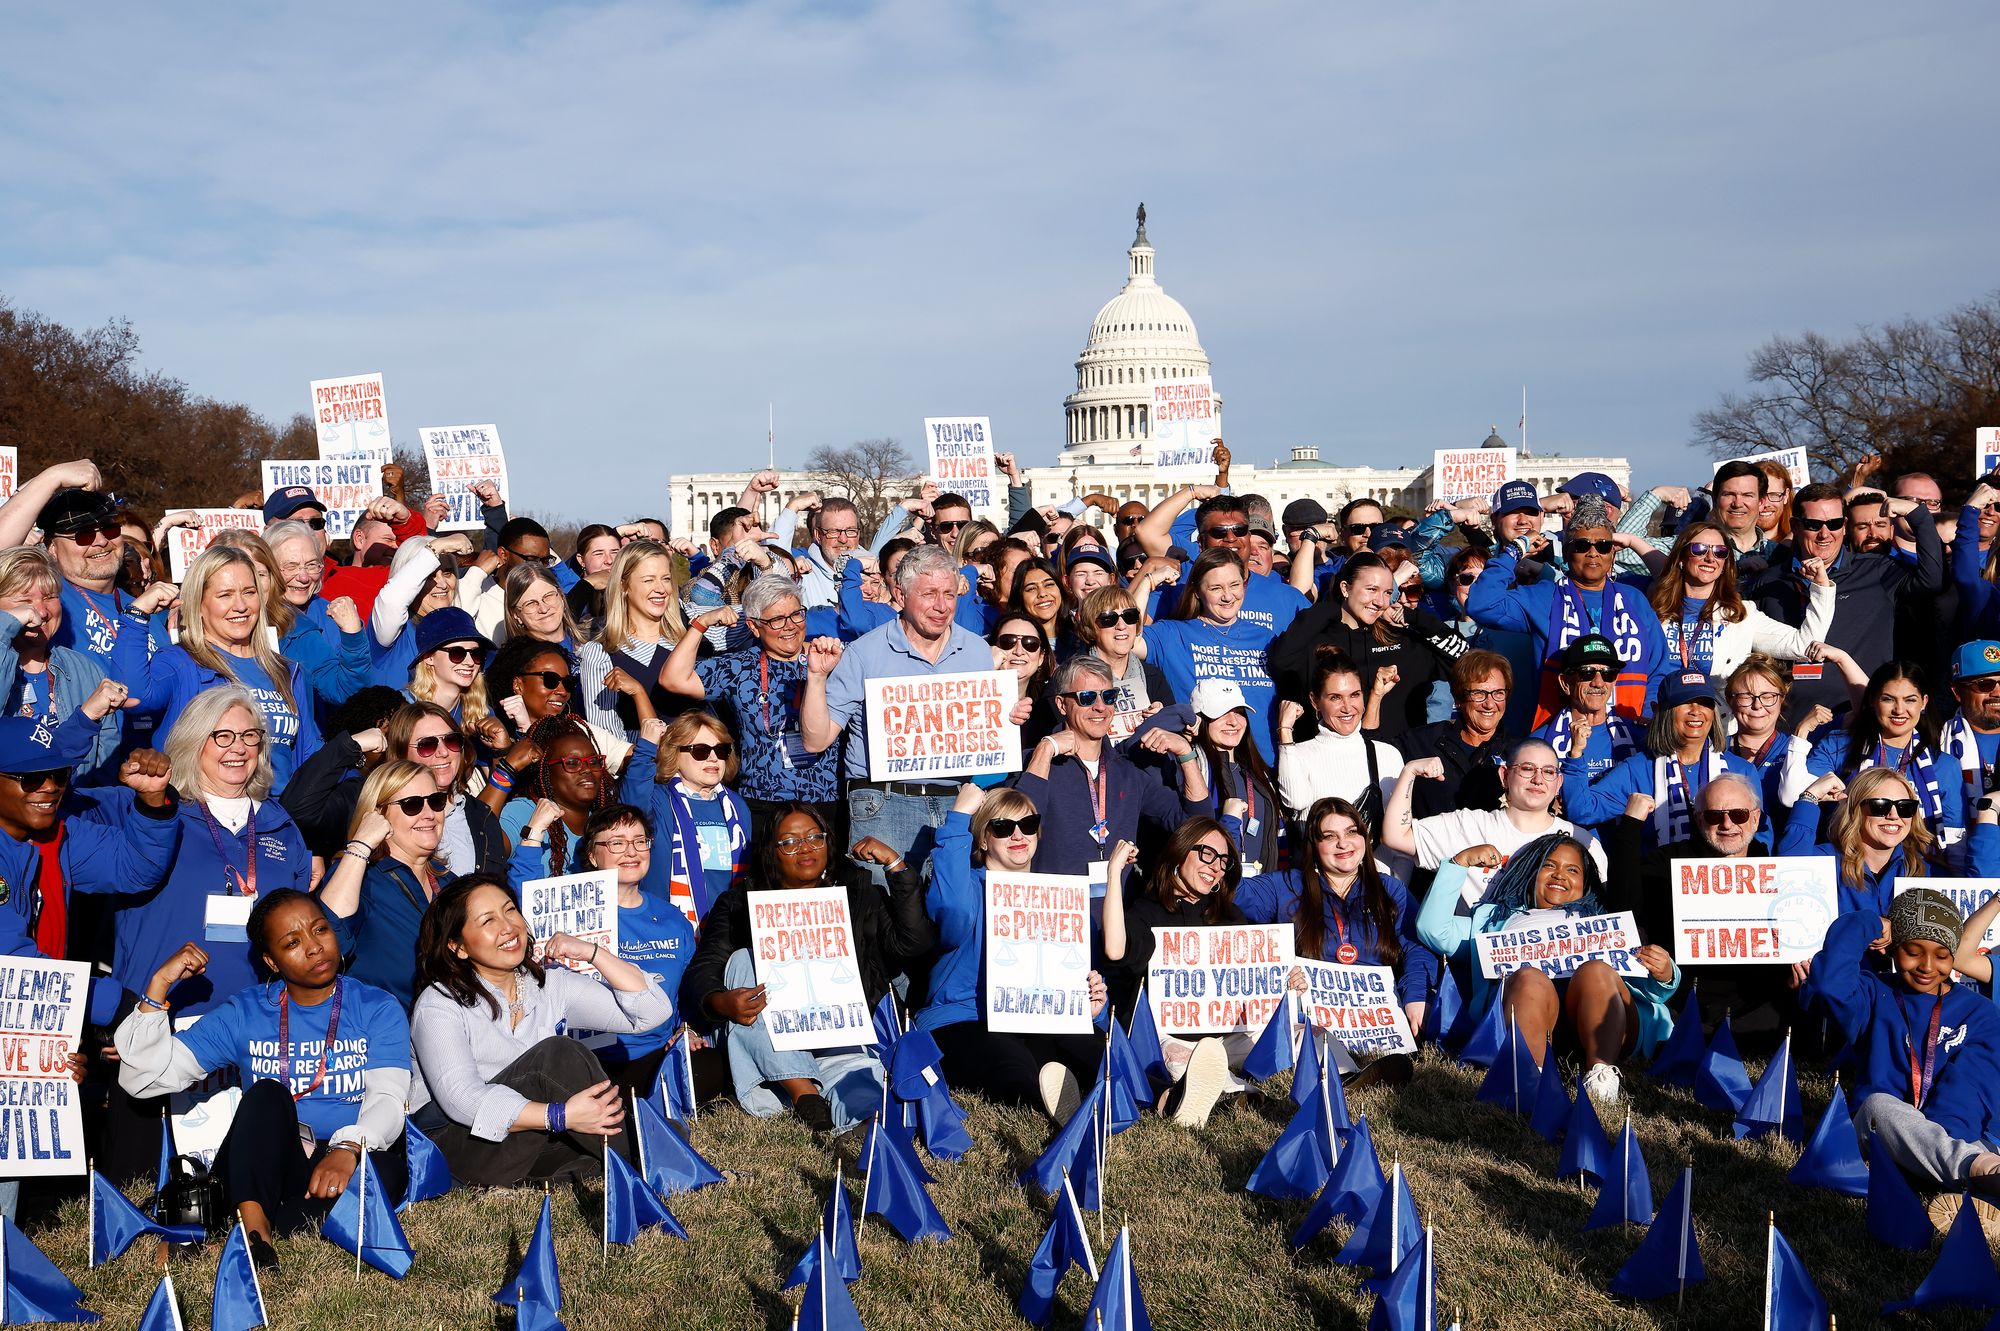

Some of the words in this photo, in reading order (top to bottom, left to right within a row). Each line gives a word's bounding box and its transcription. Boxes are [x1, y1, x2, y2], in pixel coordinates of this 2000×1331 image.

[316, 381, 381, 403] PREVENTION
[1155, 383, 1211, 401] PREVENTION
[320, 408, 332, 424] IS
[333, 399, 383, 424] POWER
[1156, 404, 1167, 421] IS
[1168, 400, 1211, 421] POWER
[430, 430, 490, 445] SILENCE
[931, 422, 984, 444] YOUNG
[432, 444, 465, 457] WILL
[467, 442, 492, 456] NOT
[936, 444, 972, 458] PEOPLE
[973, 446, 986, 454] ARE
[1157, 448, 1203, 467] DEMAND
[1443, 452, 1507, 465] COLORECTAL
[270, 466, 311, 485] THIS
[316, 466, 333, 485] IS
[337, 465, 372, 484] NOT
[436, 458, 473, 477] SAVE
[480, 458, 501, 474] US
[938, 458, 988, 478] DYING
[1443, 464, 1507, 482] CANCER
[947, 479, 989, 489] COLORECTAL
[1443, 482, 1454, 495] IS
[1456, 482, 1465, 495] A
[1466, 481, 1503, 494] CRISIS
[443, 495, 486, 523] WIL
[1191, 643, 1220, 656] MORE
[1223, 646, 1267, 658] FUNDING
[1371, 646, 1389, 654] FIGHT
[1389, 643, 1402, 652] CRC
[1192, 653, 1220, 664] MORE
[1222, 656, 1268, 667] RESEARCH
[1194, 663, 1236, 678] MORE
[1237, 665, 1269, 678] TIM
[1252, 679, 1273, 688] CANCER
[1683, 675, 1703, 683] FIGHT
[882, 679, 1002, 704] COLORECTAL
[883, 699, 1003, 736] CANCER
[887, 736, 906, 757] IS
[912, 736, 927, 756] A
[930, 730, 1004, 755] CRISIS.
[887, 757, 926, 773] TREAT
[930, 756, 942, 770] IT
[944, 754, 973, 769] LIKE
[976, 752, 1005, 768] ONE!
[1681, 864, 1779, 895] MORE
[532, 880, 605, 916] SILENCE
[993, 883, 1085, 912] PREVENTION
[532, 911, 572, 939] WILL
[576, 907, 604, 933] NOT
[755, 899, 846, 929] PREVENTION
[993, 914, 1010, 937] IS
[1013, 911, 1084, 944] POWER
[1486, 929, 1541, 949] THIS
[1547, 924, 1570, 940] IS
[1575, 916, 1622, 936] NOT
[651, 937, 679, 951] TIME!
[760, 937, 777, 961] IS
[779, 927, 849, 962] POWER
[1163, 931, 1201, 966] NO
[1209, 929, 1281, 965] MORE
[1489, 946, 1519, 956] JUST
[1520, 931, 1627, 961] GRANDPA'S
[1684, 927, 1780, 958] TIME!
[618, 952, 654, 960] COLORECTAL
[1340, 951, 1356, 959] STAFF
[1490, 955, 1519, 963] YOUR
[0, 967, 75, 1004] ILENCE
[1152, 968, 1206, 998] “TOO
[1212, 965, 1288, 997] YOUNG”
[1304, 965, 1384, 992] YOUNG
[993, 986, 1066, 1015] DEMAND
[1069, 990, 1087, 1016] IT
[1311, 990, 1368, 1007] PEOPLE
[1369, 996, 1389, 1005] ARE
[30, 1003, 70, 1032] NOT
[770, 1004, 847, 1035] DEMAND
[848, 1002, 864, 1028] IT
[1160, 1001, 1201, 1027] FOR
[1314, 1007, 1395, 1029] DYING
[1333, 1027, 1398, 1040] COLORECTAL
[2, 1038, 30, 1072] VE
[39, 1040, 69, 1074] US
[251, 1057, 290, 1075] MOR
[295, 1053, 368, 1075] RESARCH
[0, 1080, 68, 1107] SEARCH
